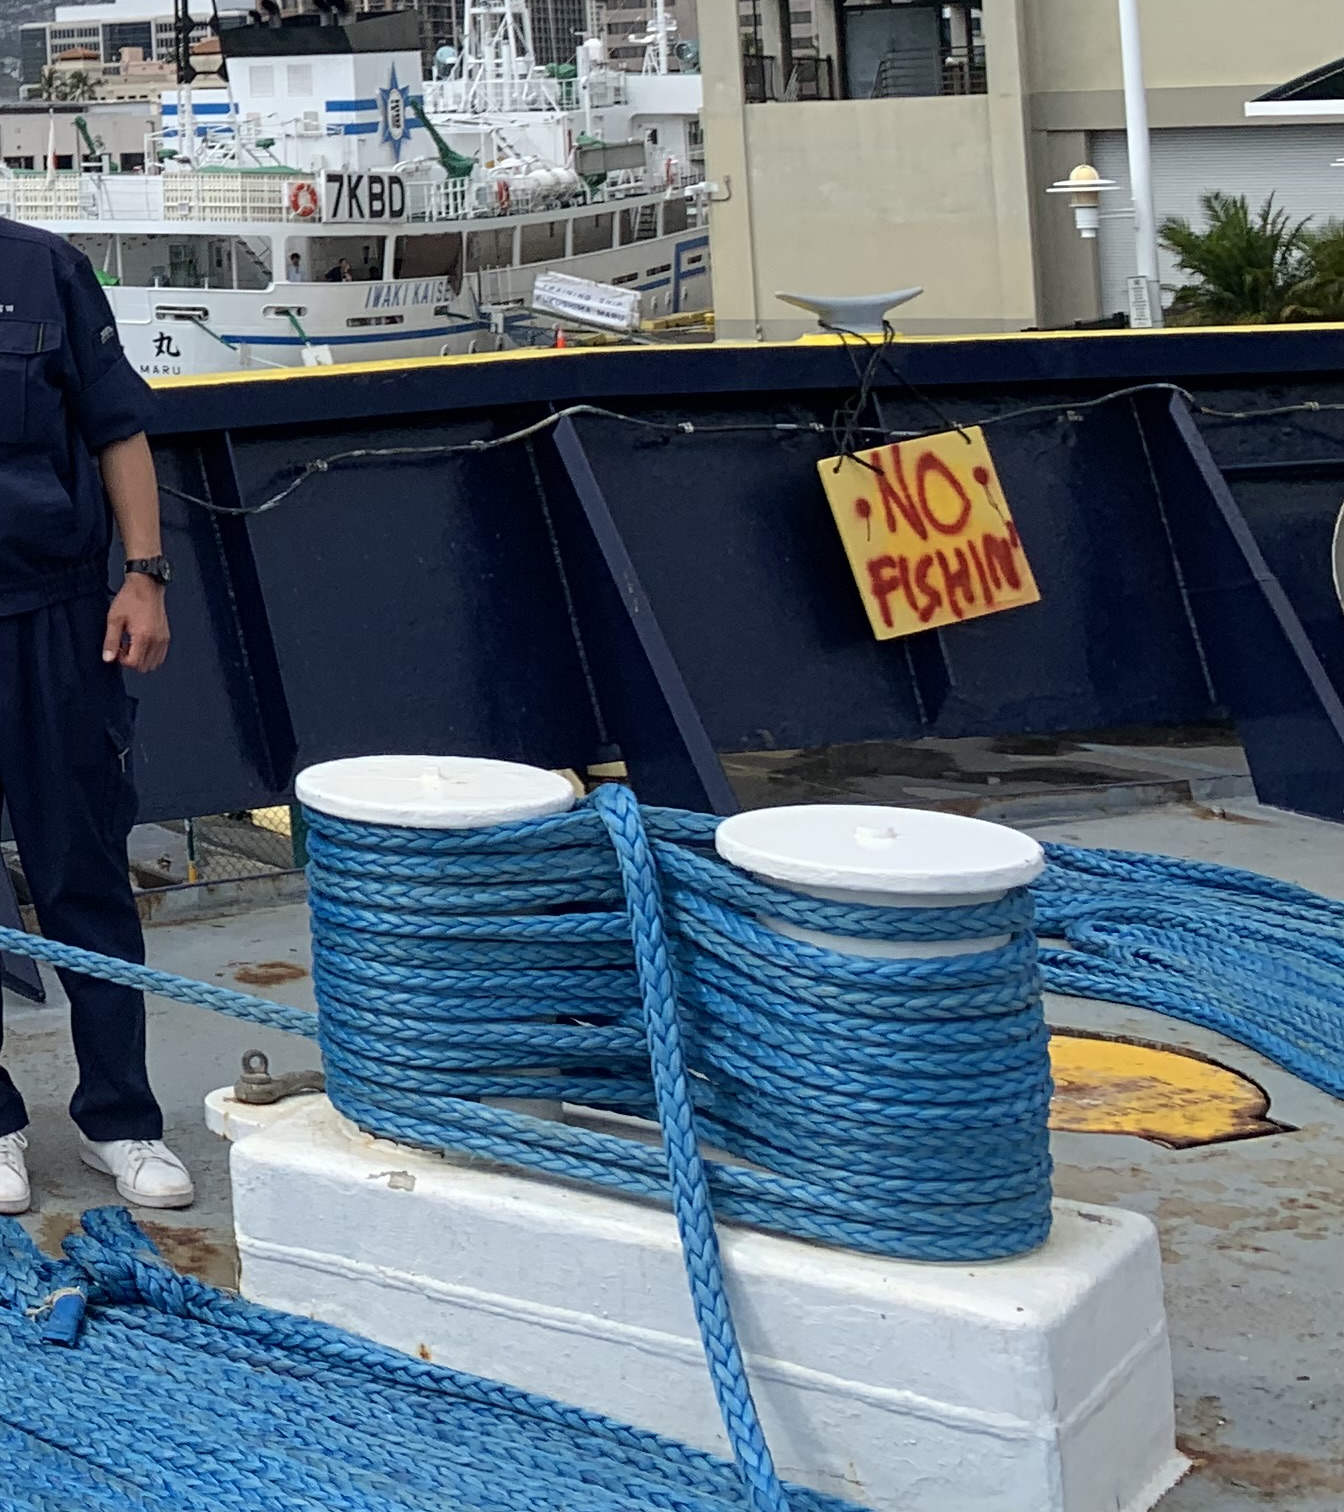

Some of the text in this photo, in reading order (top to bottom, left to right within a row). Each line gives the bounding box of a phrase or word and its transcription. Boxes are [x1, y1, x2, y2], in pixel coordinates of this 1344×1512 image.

[326, 174, 405, 218] 7KBD
[364, 283, 409, 308] IWAKI
[152, 331, 181, 357] 丸
[140, 365, 181, 375] MARU
[869, 444, 972, 540] NO
